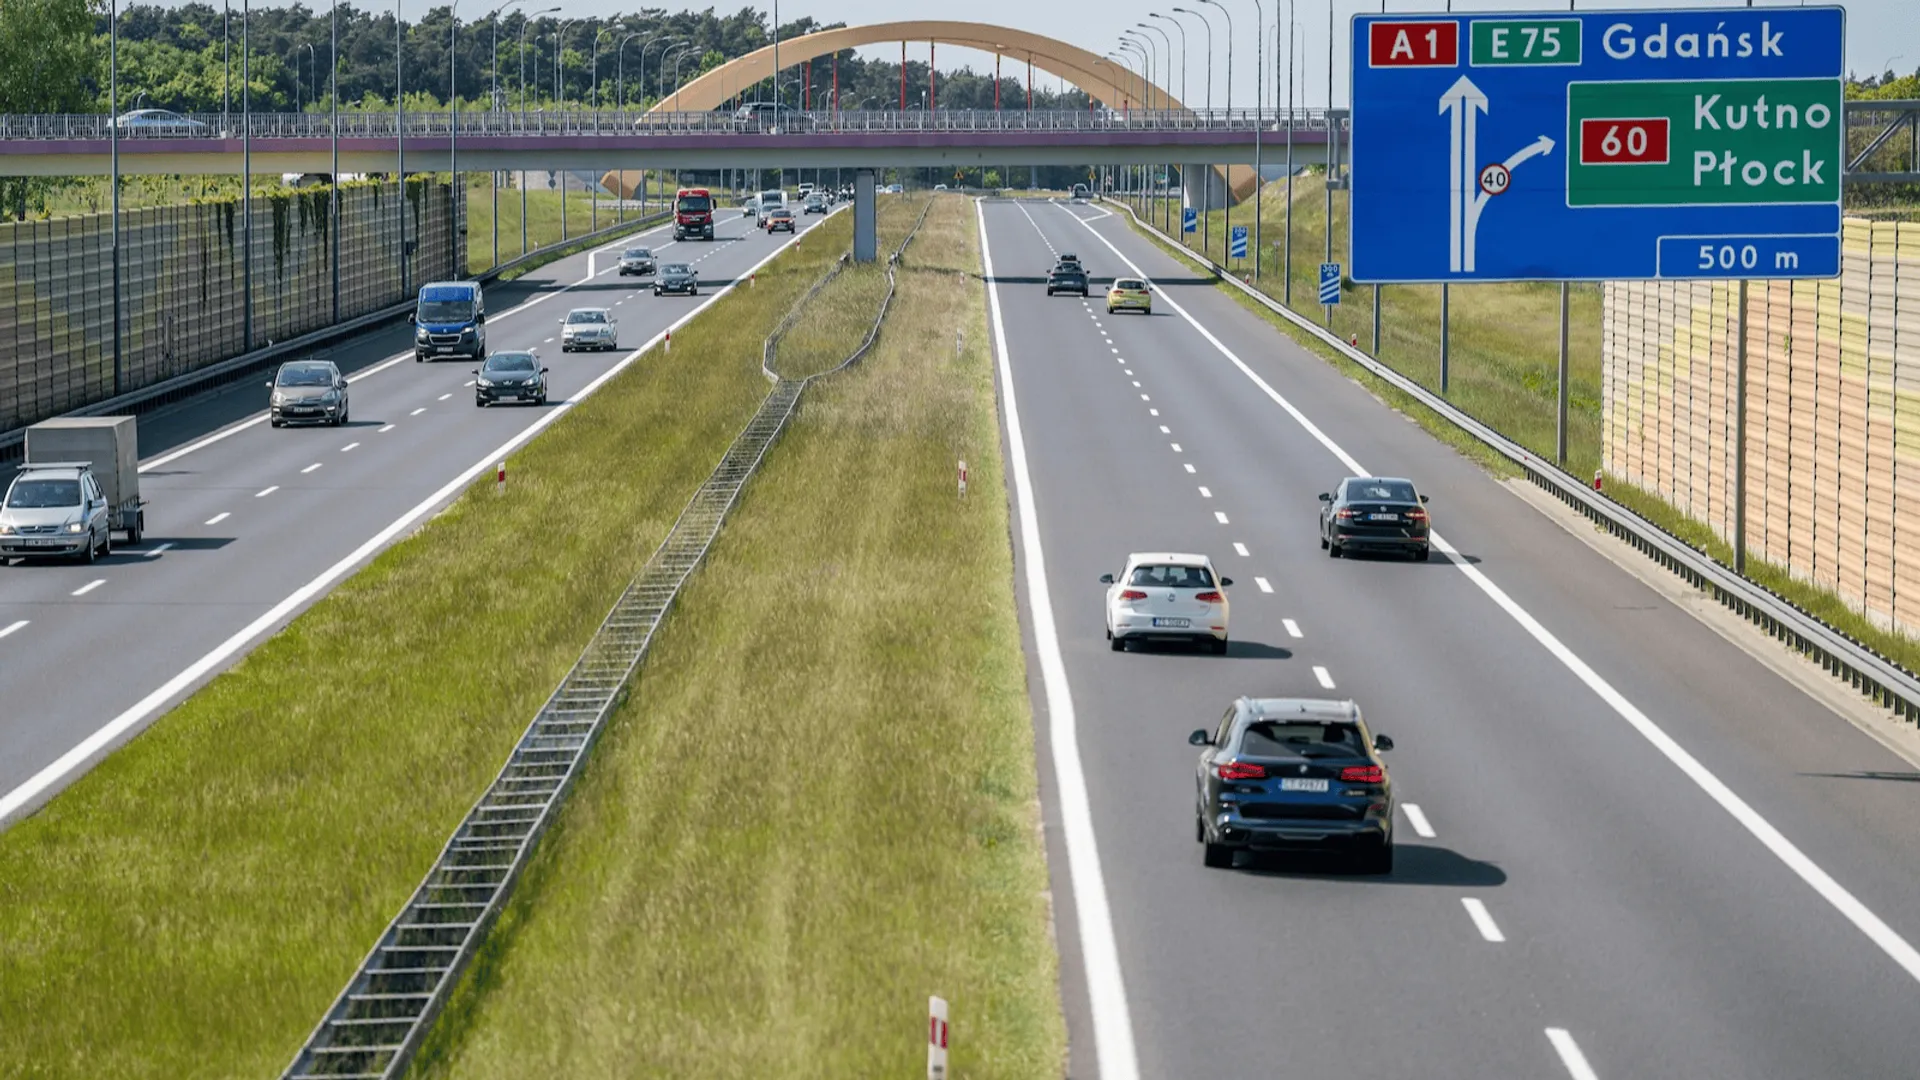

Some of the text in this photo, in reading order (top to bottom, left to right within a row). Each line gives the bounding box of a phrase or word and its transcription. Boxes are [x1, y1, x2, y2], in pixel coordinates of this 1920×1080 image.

[1603, 22, 1783, 60] Gdańsk
[1694, 94, 1831, 130] Kutno
[1601, 126, 1647, 157] 60
[1483, 171, 1506, 188] 40
[1694, 150, 1824, 186] Płock
[1700, 245, 1798, 269] 500 m
